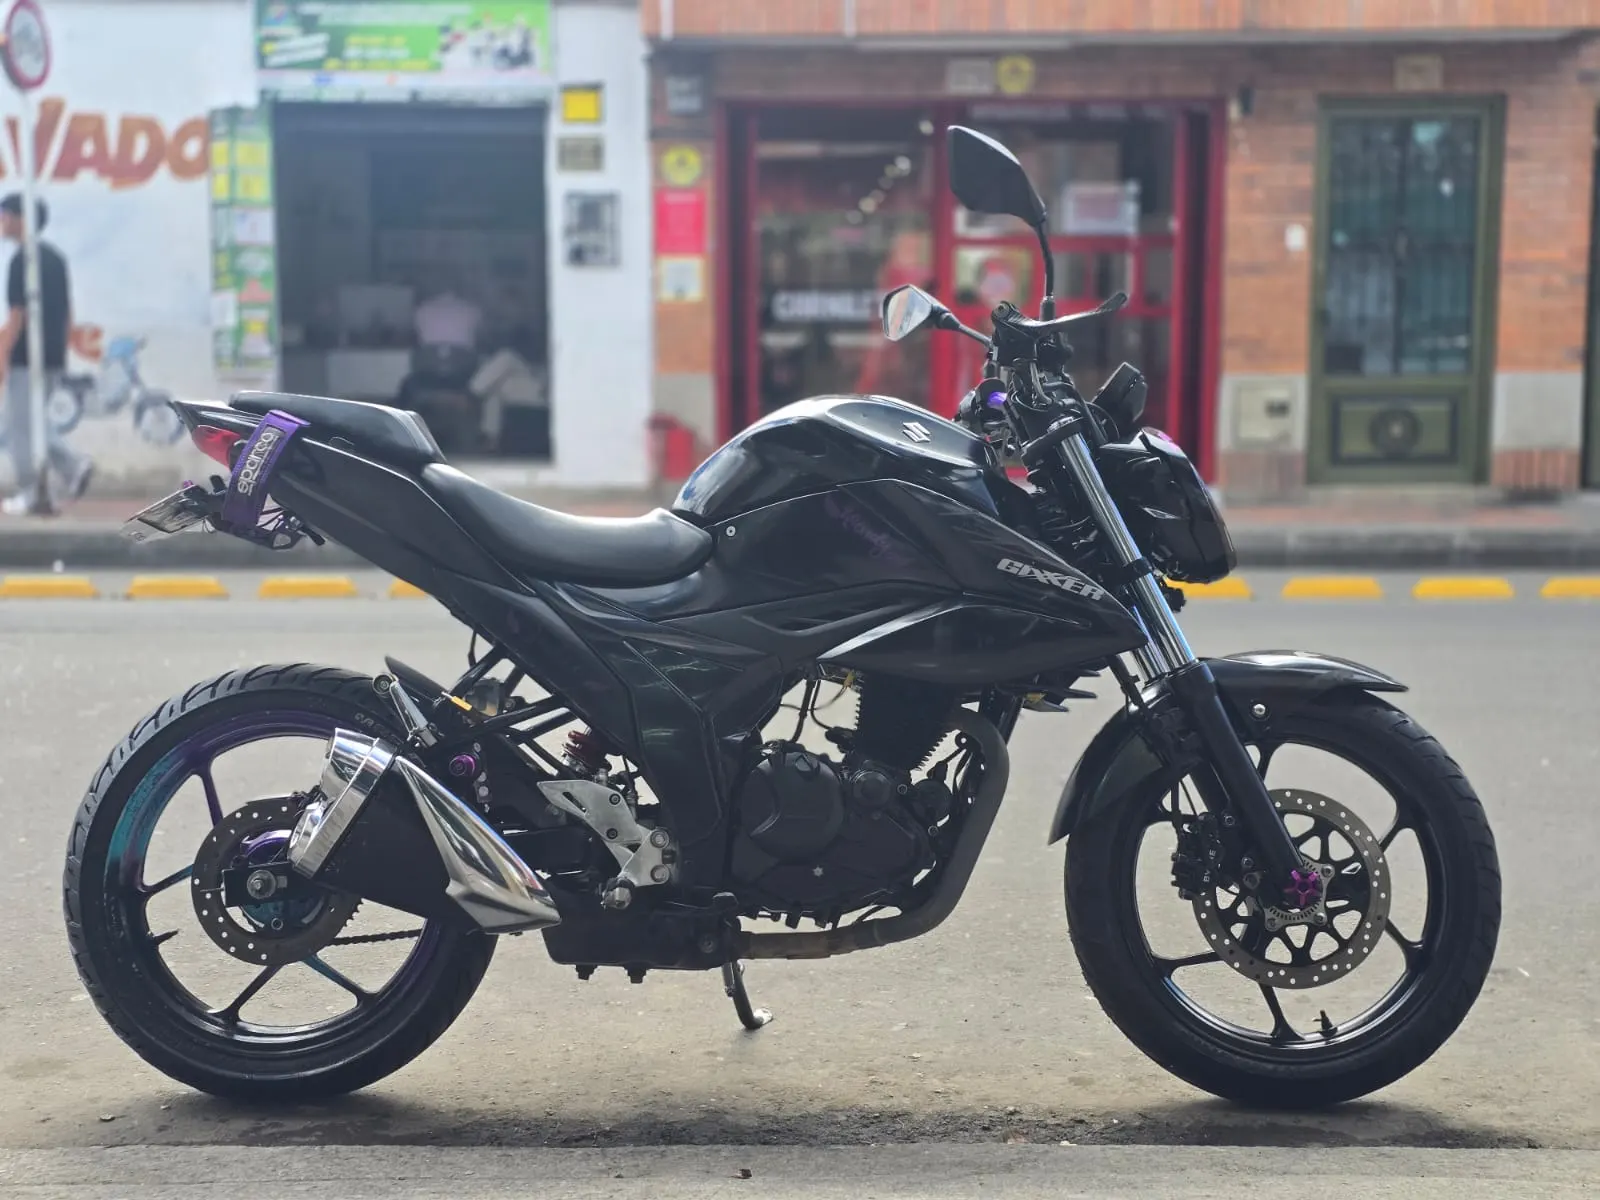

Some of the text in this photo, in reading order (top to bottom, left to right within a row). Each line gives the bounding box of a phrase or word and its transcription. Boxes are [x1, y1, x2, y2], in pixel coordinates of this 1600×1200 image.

[0, 97, 208, 190] VADO
[237, 432, 277, 495] sparco
[997, 558, 1106, 601] GIXXER
